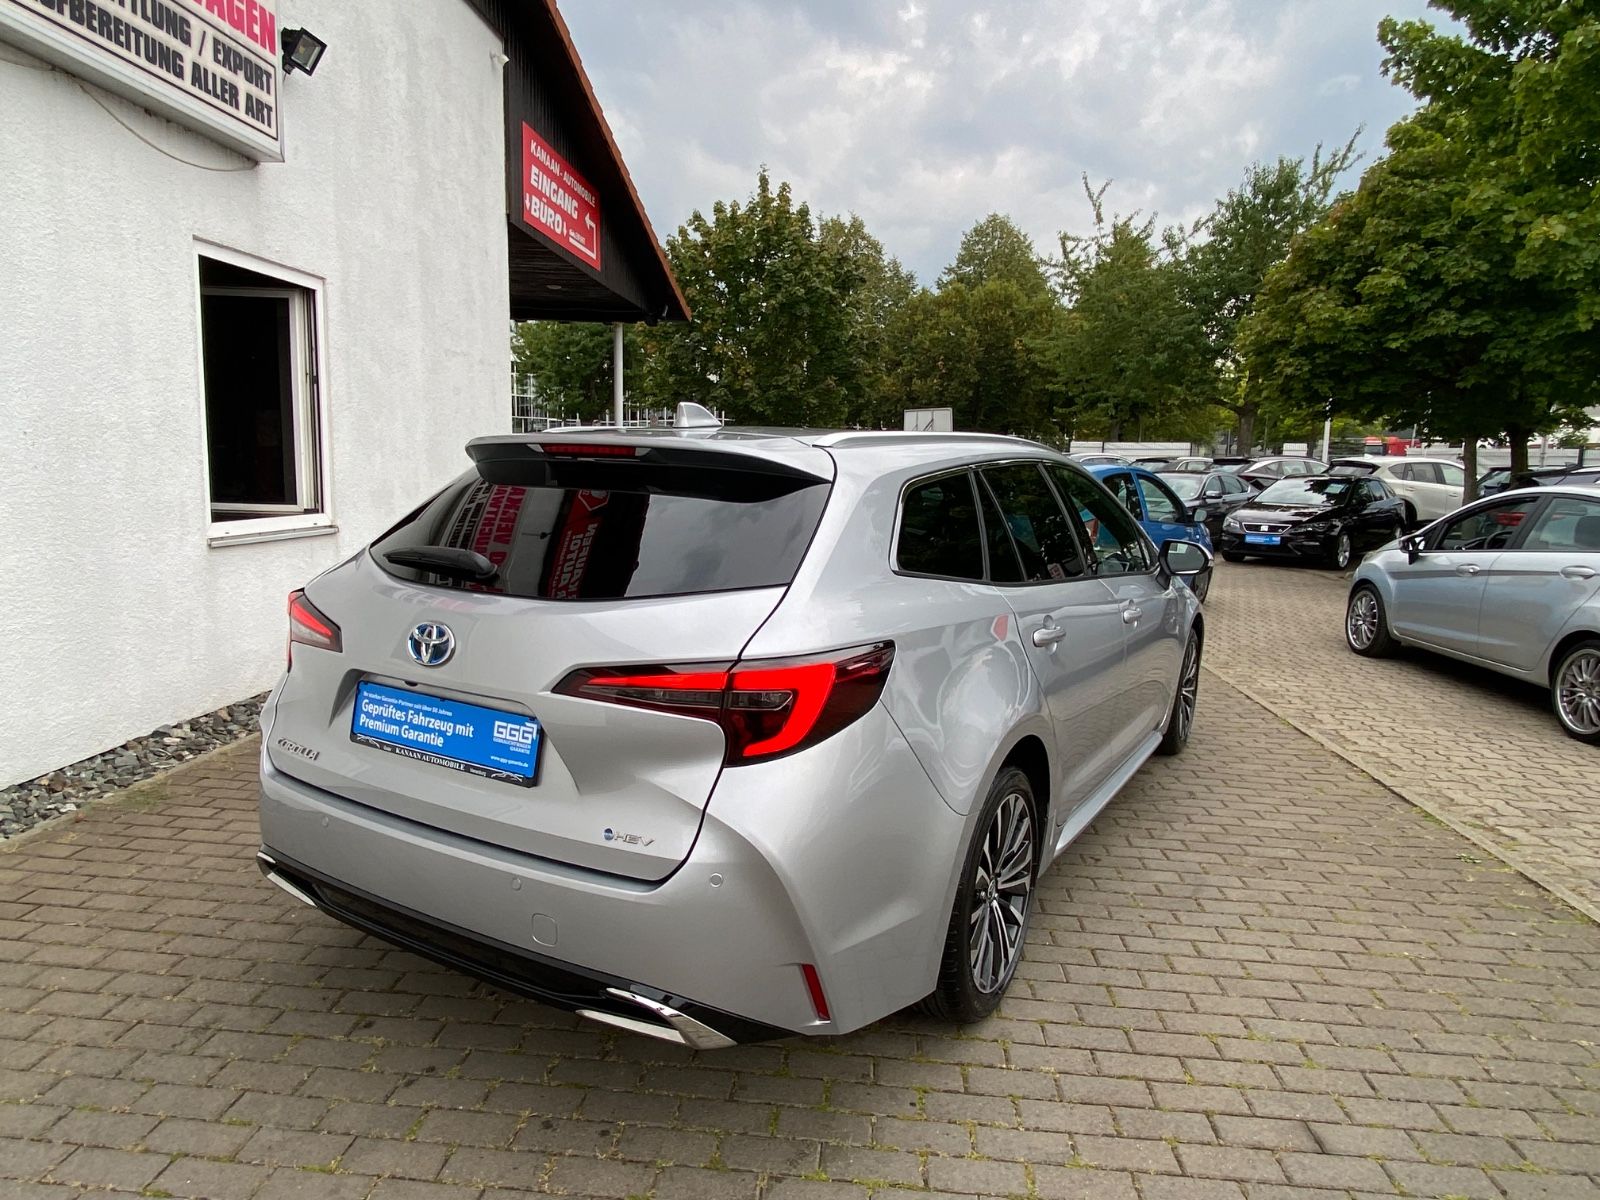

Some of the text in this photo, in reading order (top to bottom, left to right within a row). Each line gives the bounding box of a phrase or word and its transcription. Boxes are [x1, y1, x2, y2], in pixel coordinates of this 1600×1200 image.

[193, 0, 276, 56] GEN
[213, 37, 272, 95] EXPORT
[191, 62, 240, 111] ALLER
[245, 93, 273, 129] ART
[530, 139, 560, 177] KANAAN
[563, 171, 595, 204] AUTOMOBILE
[530, 164, 578, 220] EINGANG
[530, 195, 562, 235] BÜRO
[360, 714, 444, 747] Premium Garantie
[361, 699, 474, 738] Geprüftes Fahrzeug mit
[493, 720, 535, 744] GGG
[395, 747, 421, 759] KANAAN
[422, 755, 465, 771] AUTOMOBILE
